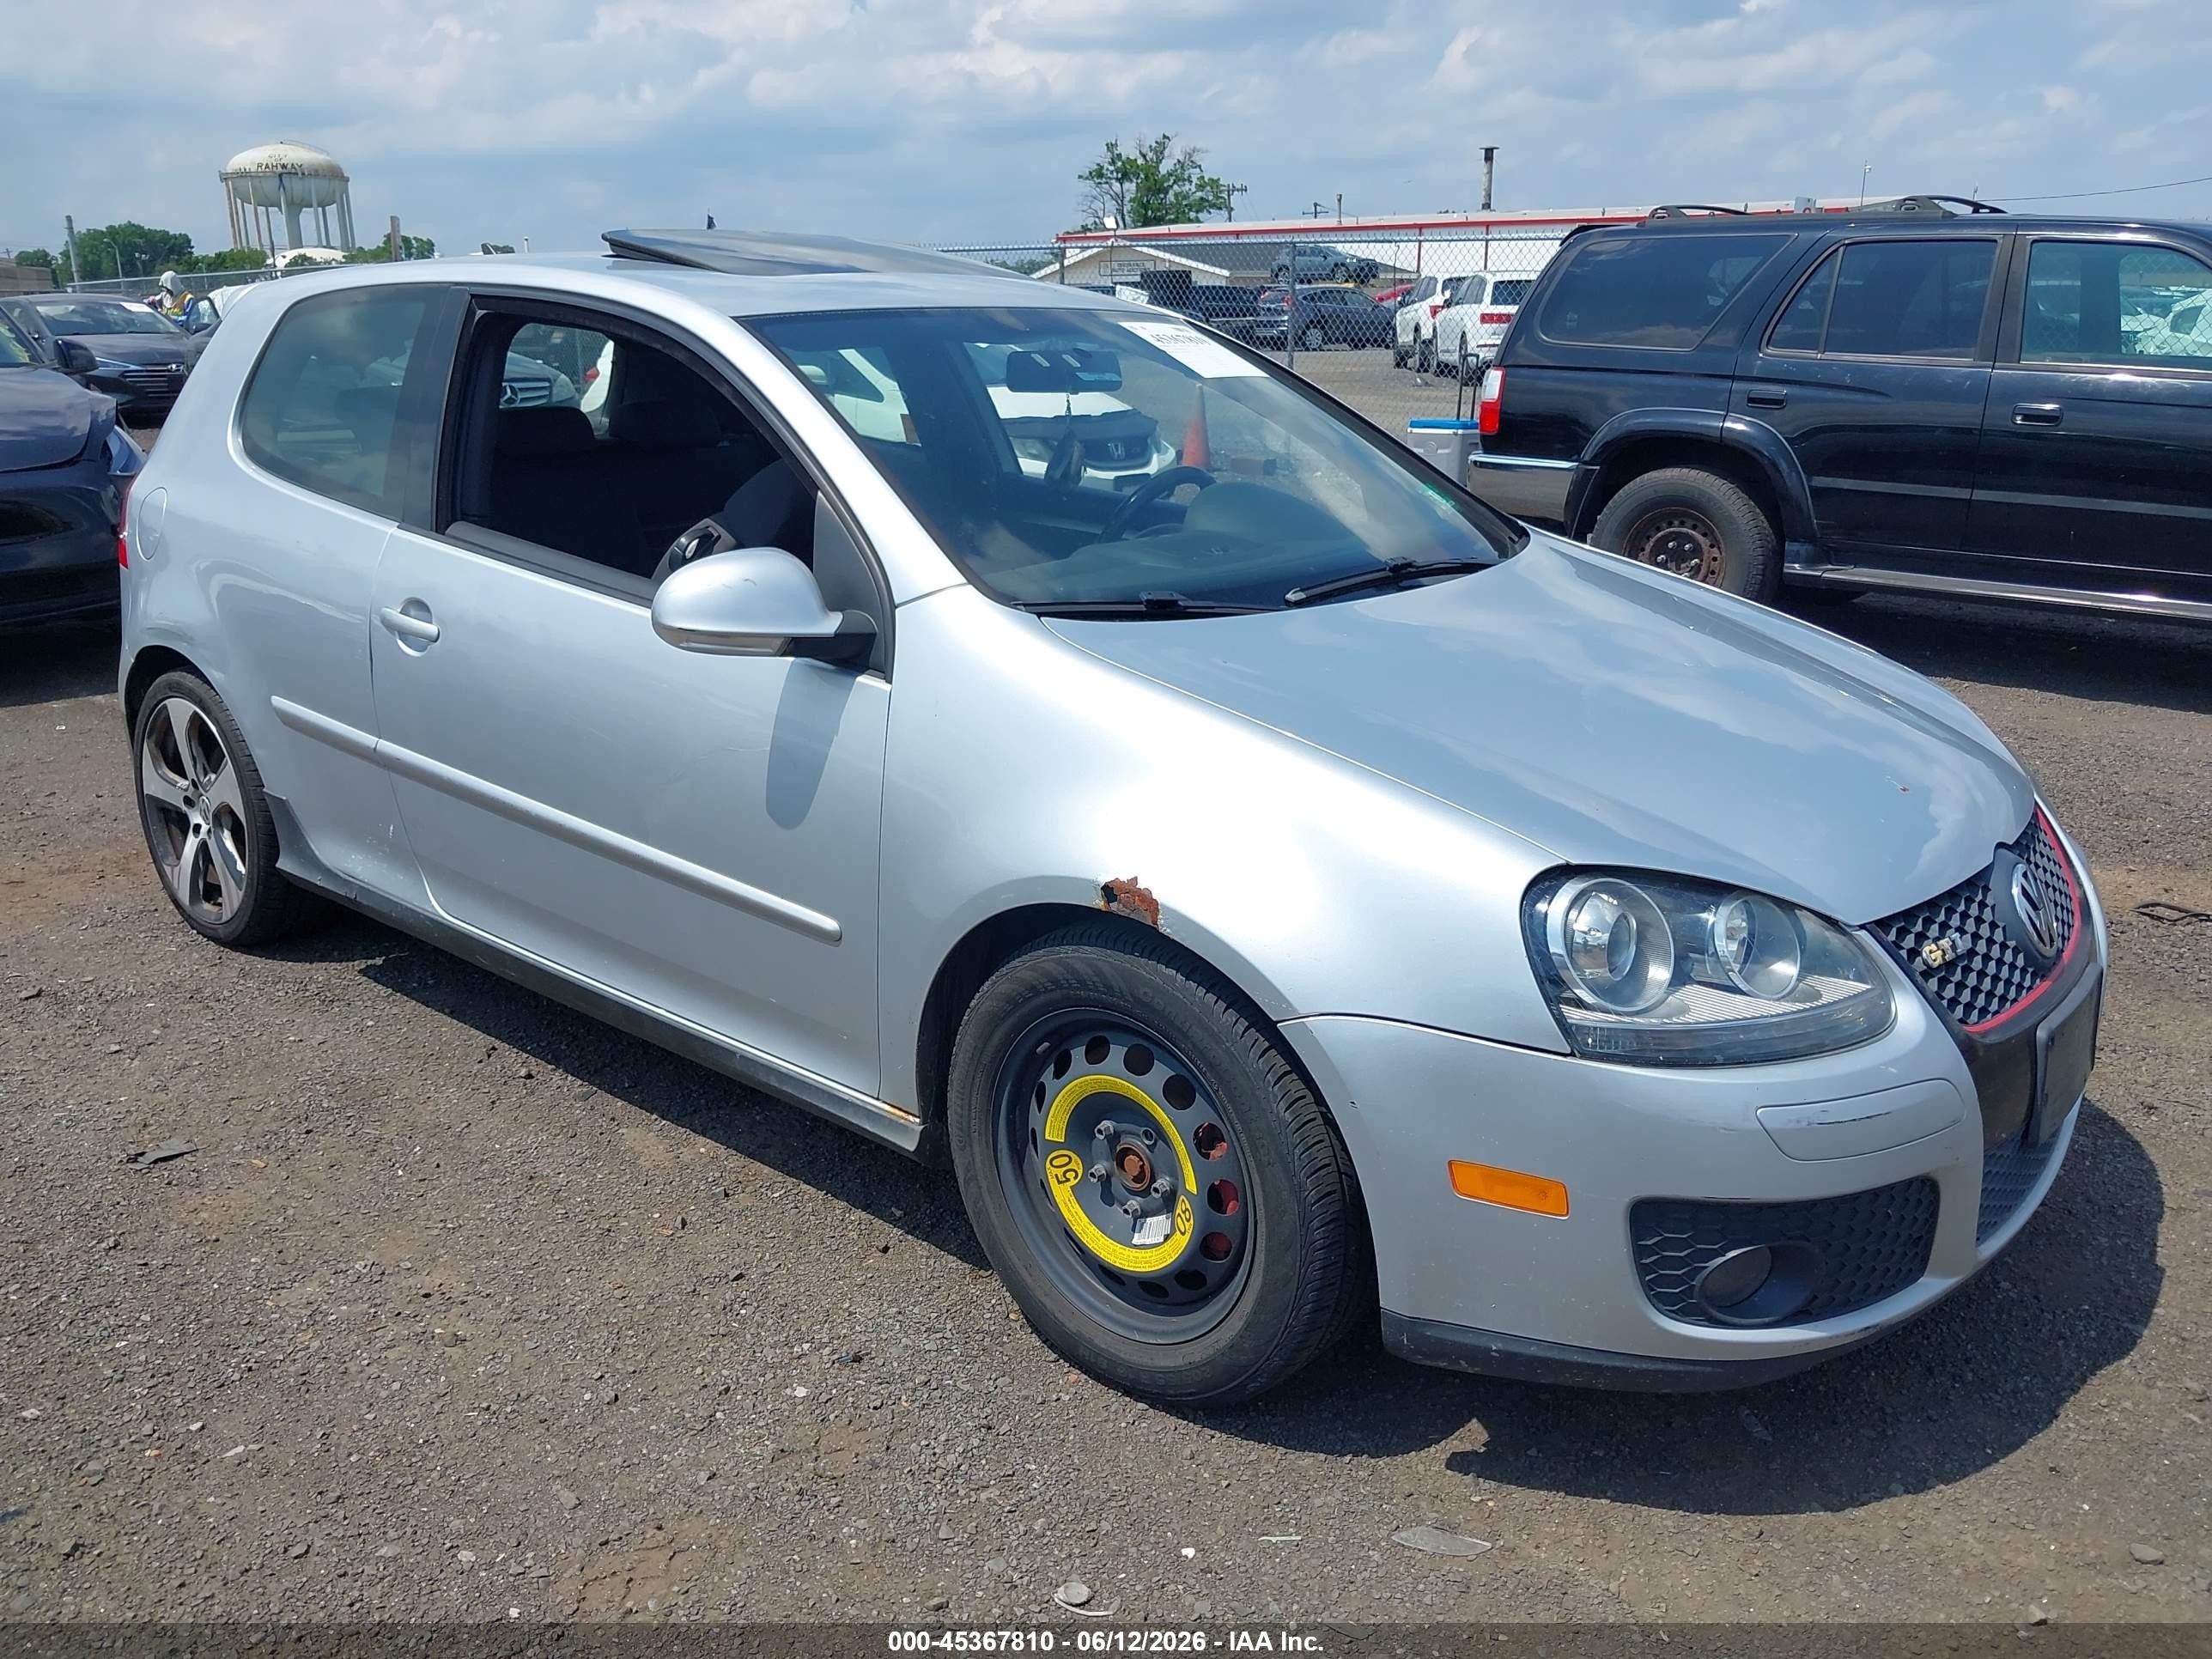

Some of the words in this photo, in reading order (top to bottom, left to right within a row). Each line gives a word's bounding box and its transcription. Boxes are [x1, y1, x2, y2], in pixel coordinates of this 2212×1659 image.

[257, 162, 303, 171] RAHWAY
[1048, 1153, 1079, 1185] 50
[1176, 1200, 1192, 1237] 80
